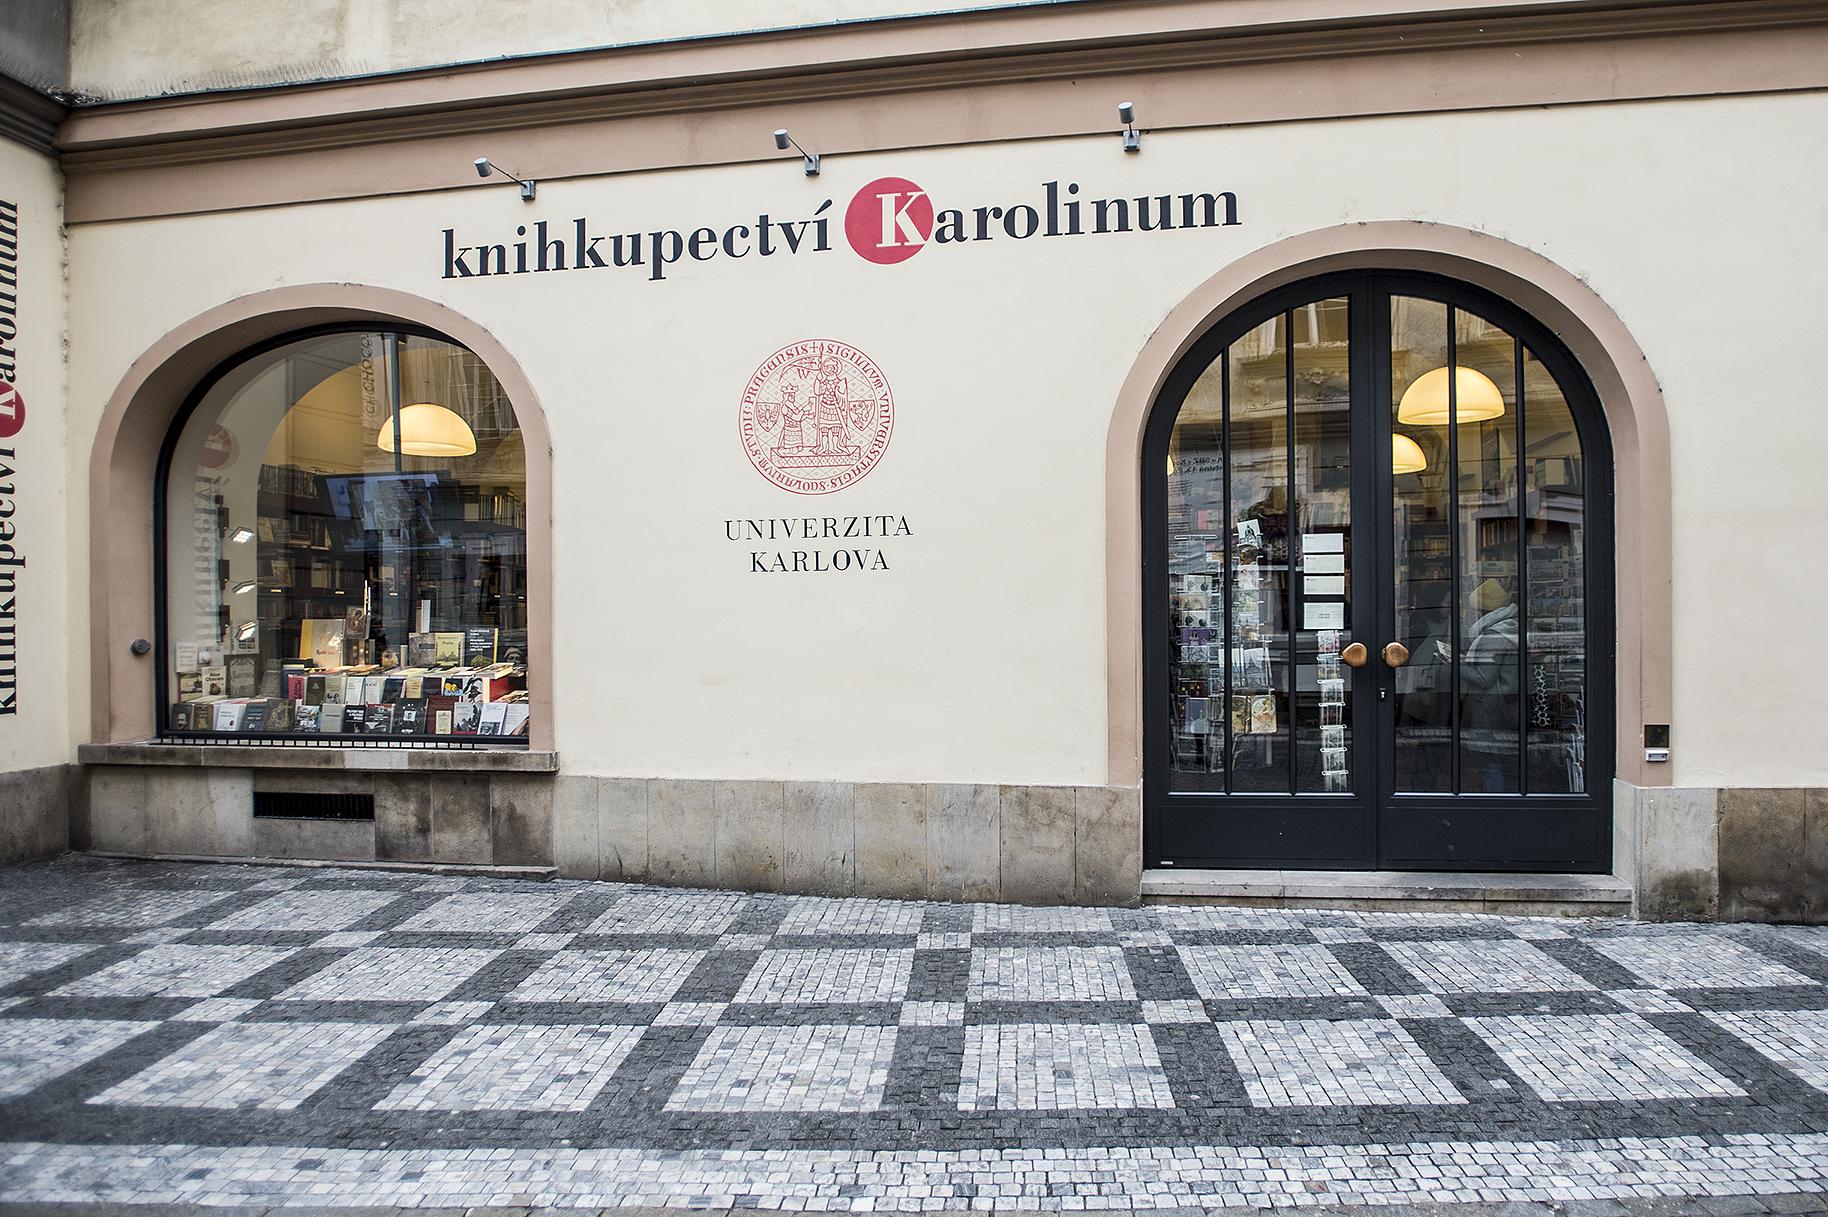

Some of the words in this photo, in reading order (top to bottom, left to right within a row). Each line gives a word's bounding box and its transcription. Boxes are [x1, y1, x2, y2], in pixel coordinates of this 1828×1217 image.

[441, 198, 833, 281] knihkupectví
[875, 180, 1243, 248] Karolinum
[724, 515, 914, 541] UNIVERZITA
[750, 549, 890, 573] KARLOVA
